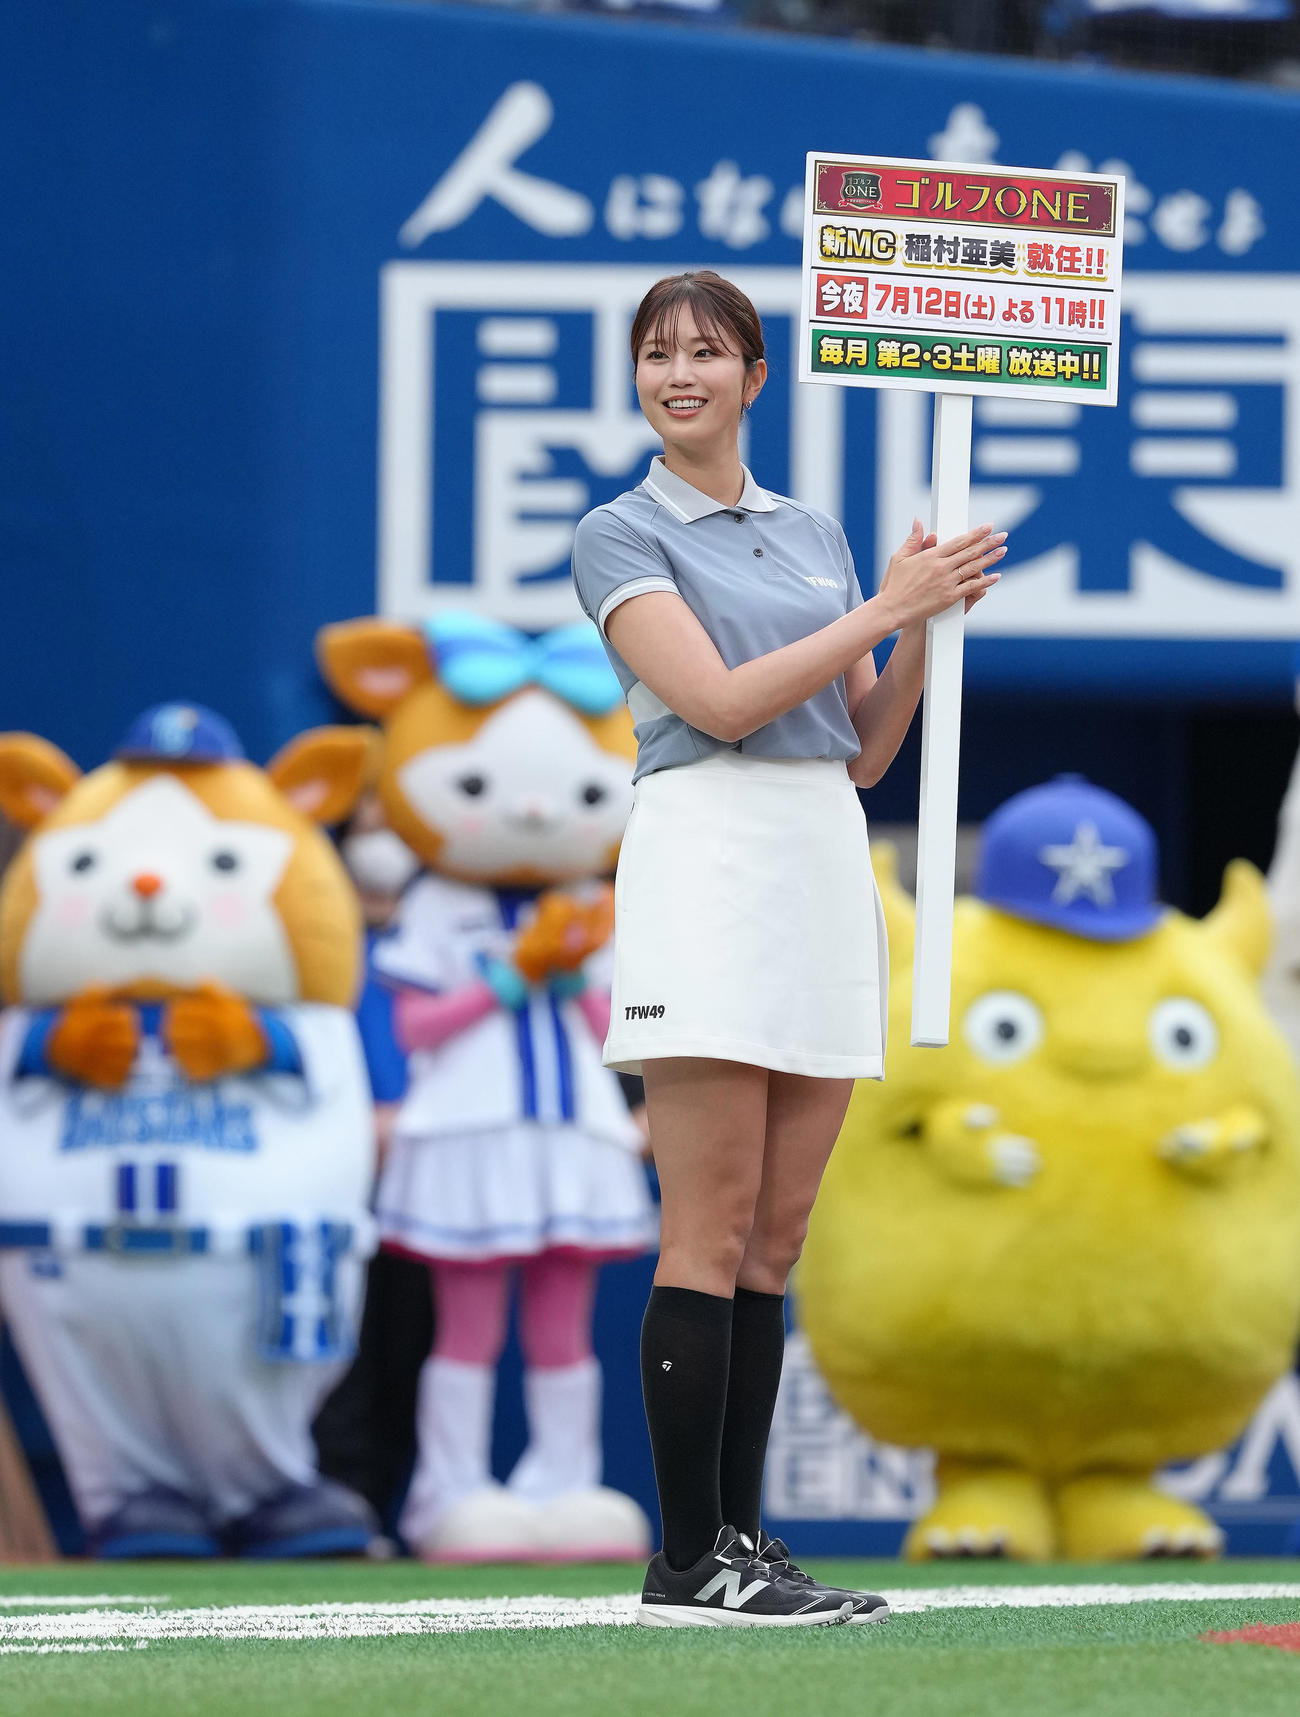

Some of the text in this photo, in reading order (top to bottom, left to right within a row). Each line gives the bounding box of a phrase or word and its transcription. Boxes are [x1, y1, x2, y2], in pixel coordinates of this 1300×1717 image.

[844, 184, 878, 198] ONE
[821, 225, 1105, 275] 新MC 稲村亜美 就任!!
[820, 279, 1105, 330] 今夜 7月12日(土) よる 11時!!
[819, 335, 869, 367] 毎月
[1008, 346, 1101, 381] 放送中!!
[624, 1004, 666, 1021] TFW49
